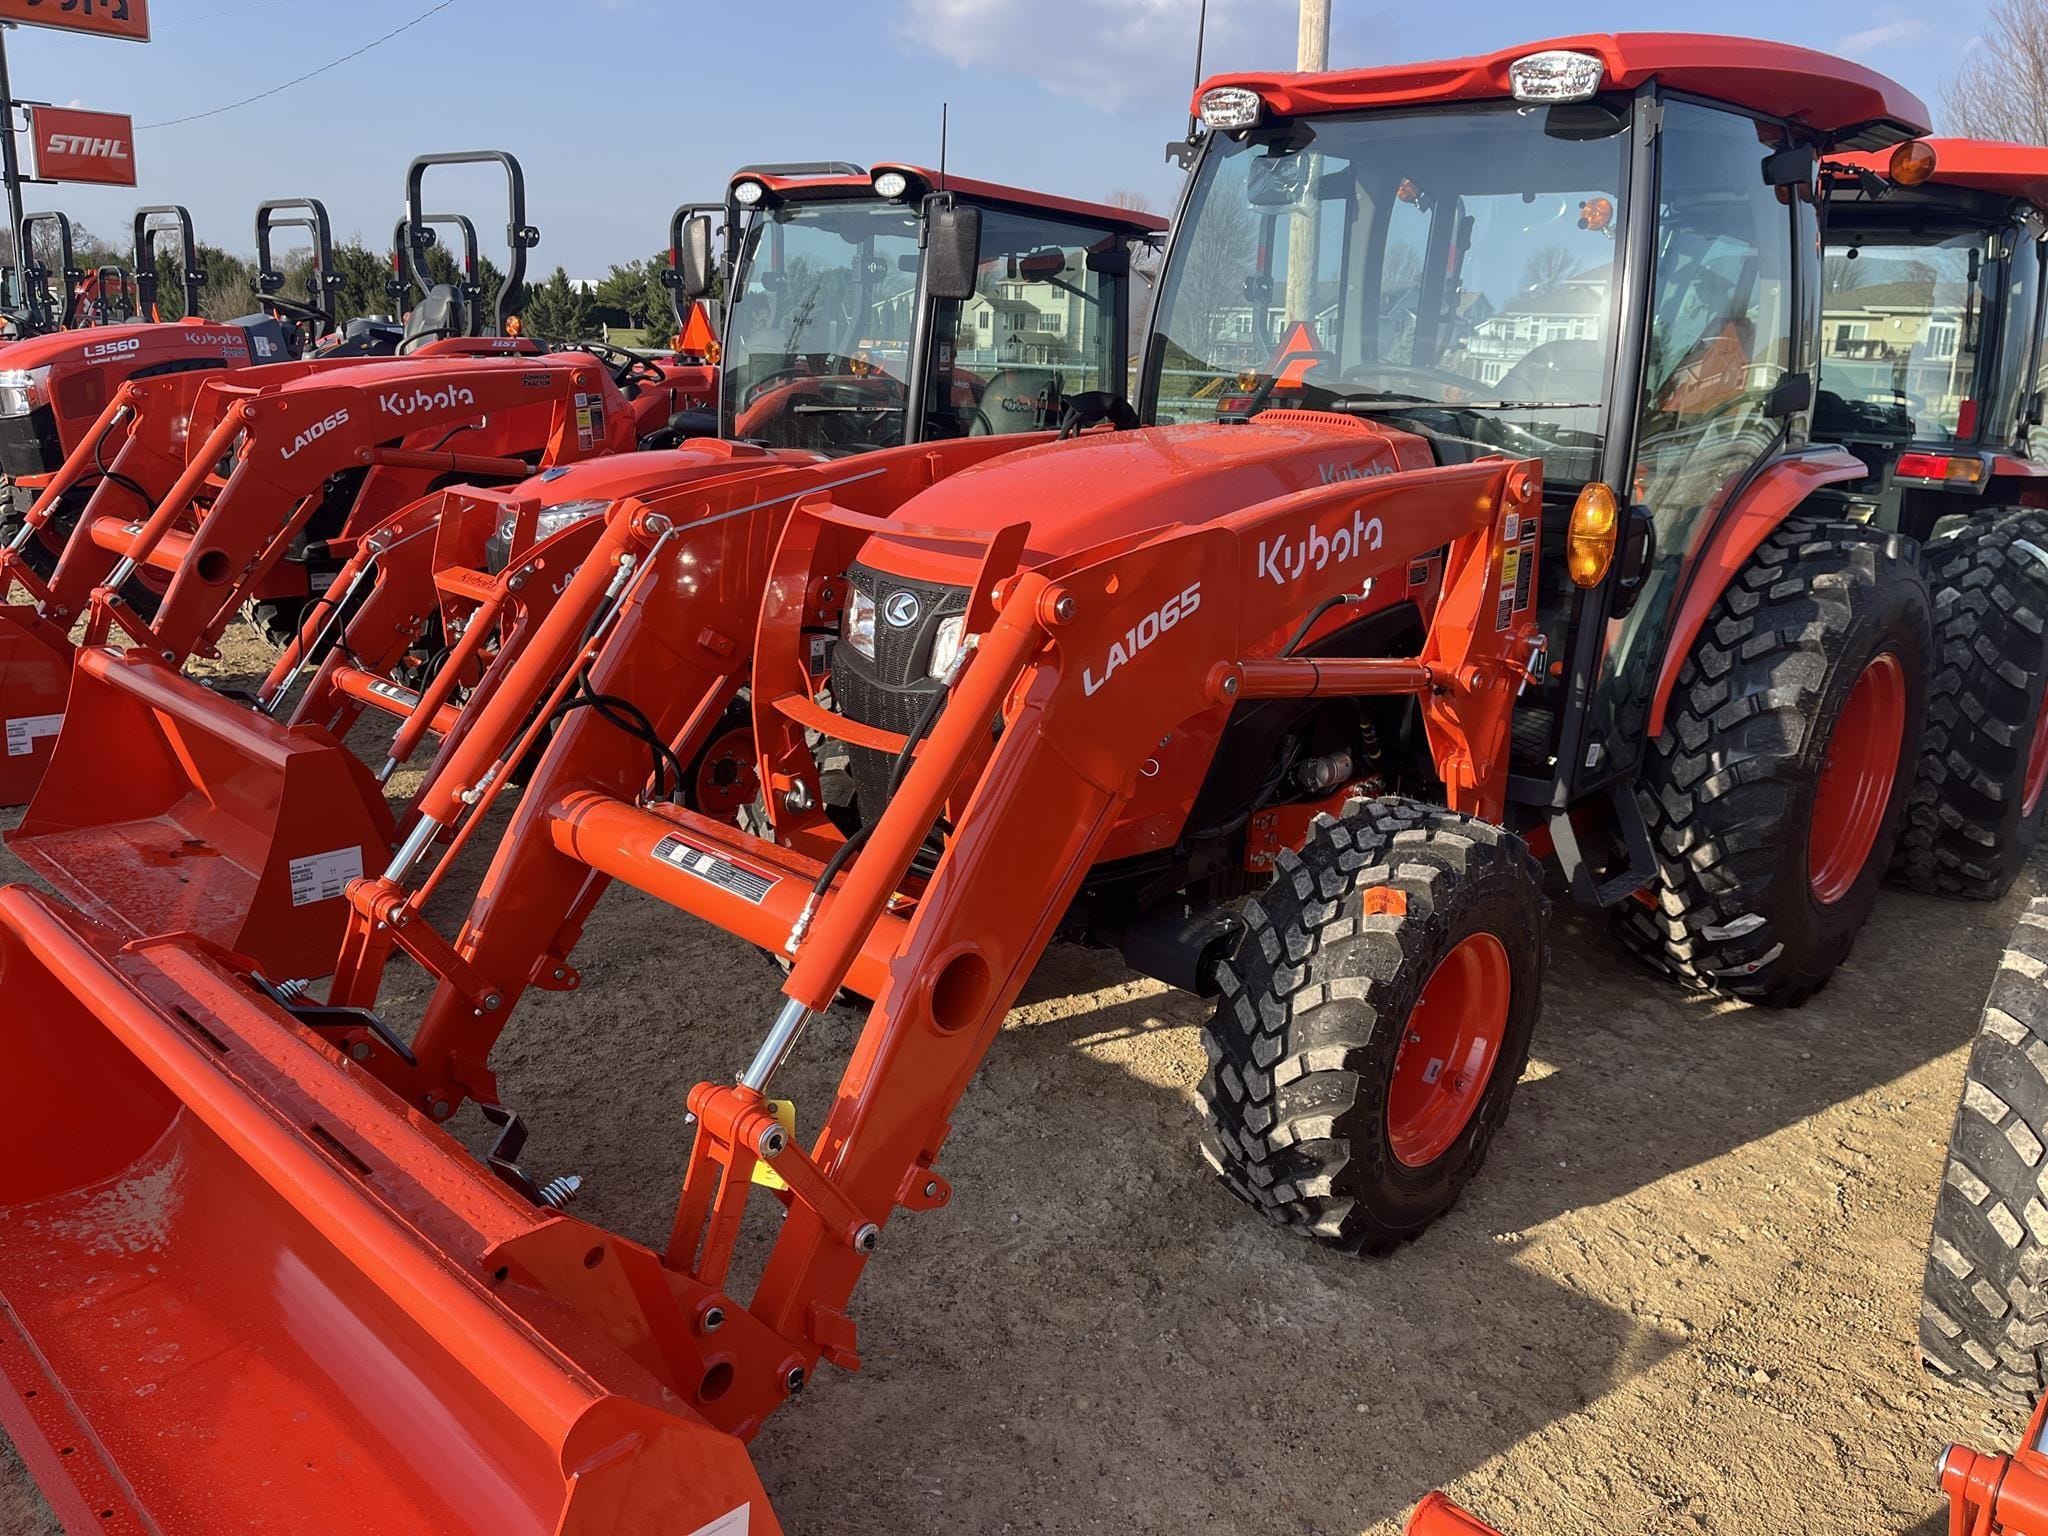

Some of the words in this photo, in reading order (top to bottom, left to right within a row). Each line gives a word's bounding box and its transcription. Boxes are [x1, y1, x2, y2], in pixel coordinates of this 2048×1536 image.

[47, 133, 128, 160] STIHL
[84, 339, 139, 357] L3560
[186, 332, 243, 345] Kubota
[379, 384, 475, 416] Kubota
[280, 407, 350, 460] LA1065
[1257, 509, 1384, 585] Kubota
[1082, 580, 1202, 697] LA1065
